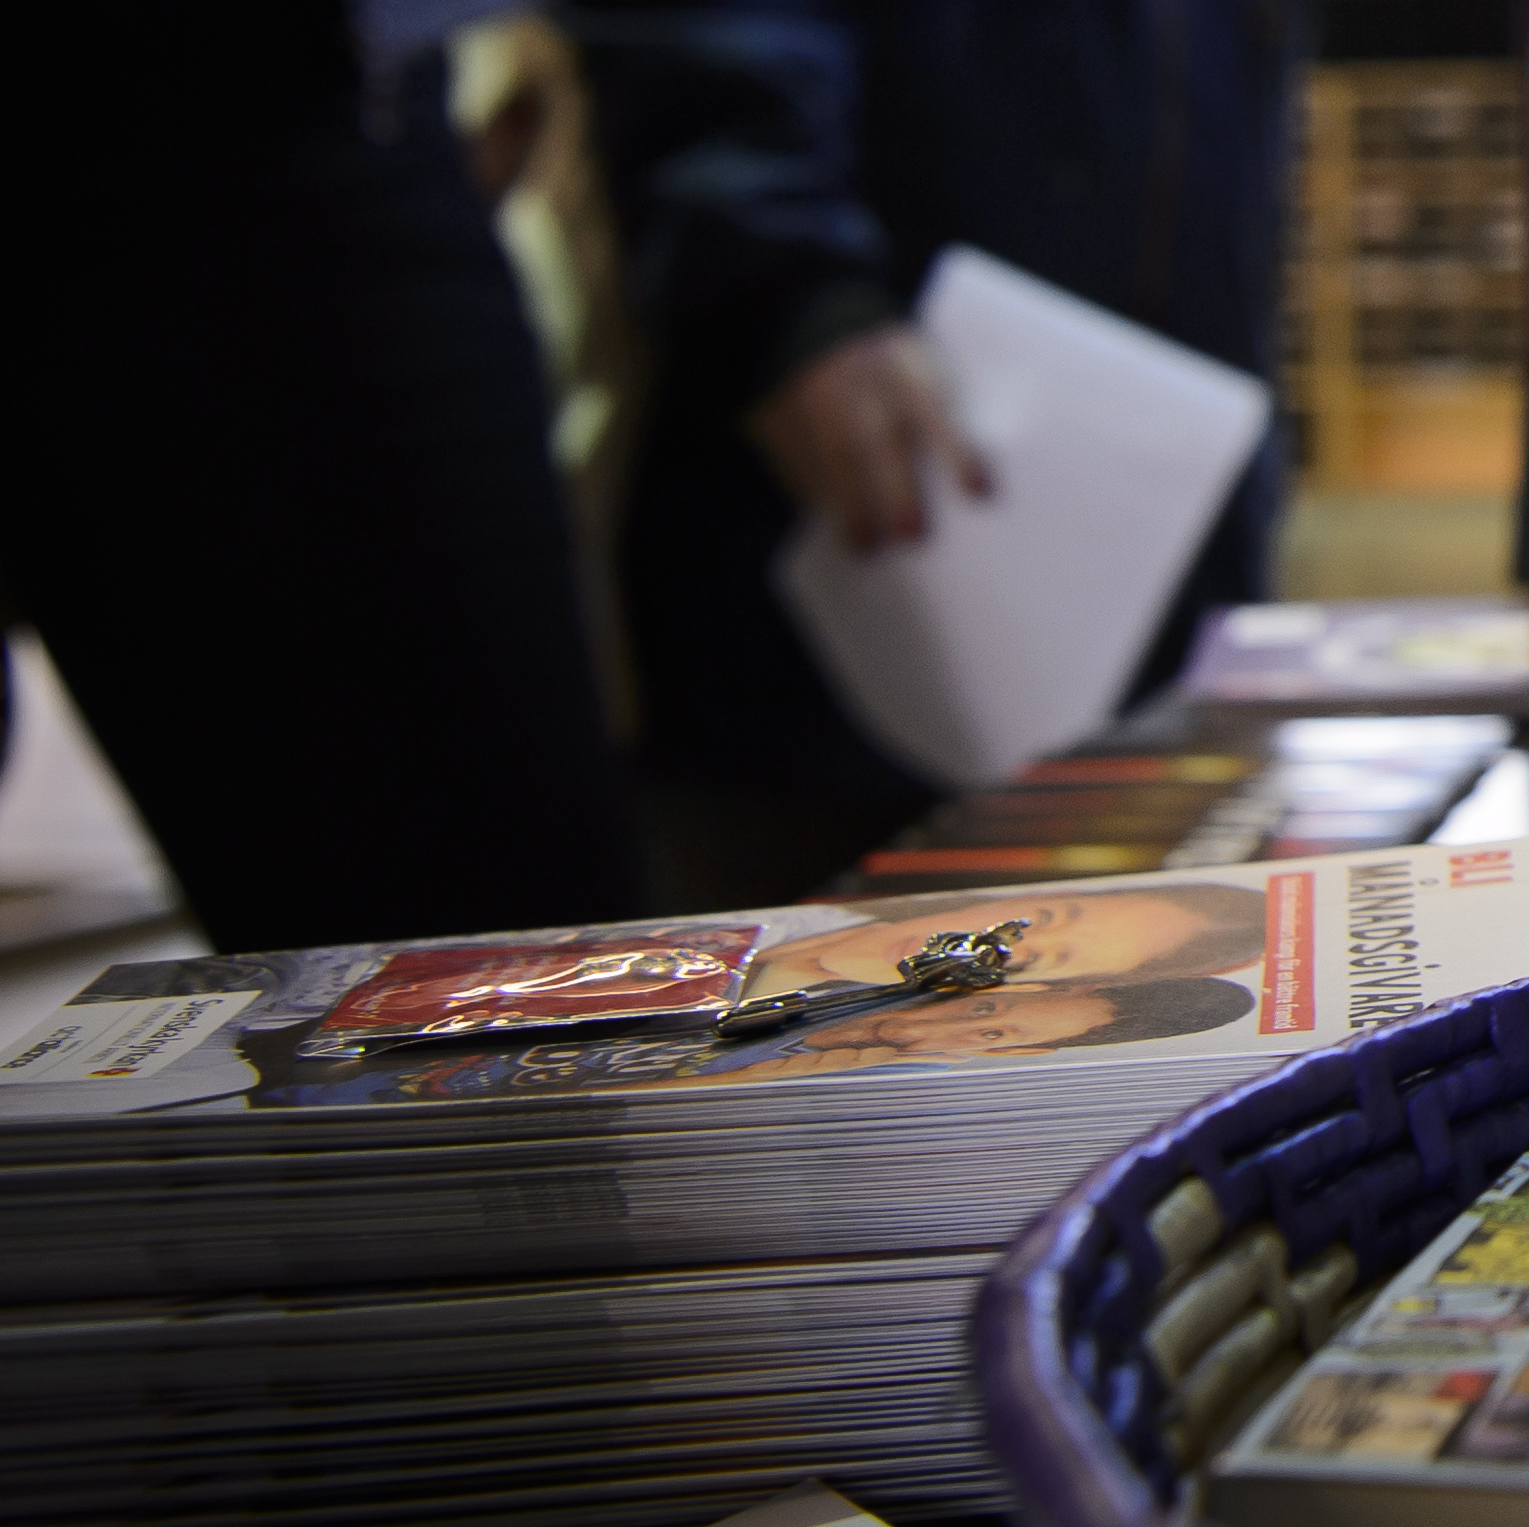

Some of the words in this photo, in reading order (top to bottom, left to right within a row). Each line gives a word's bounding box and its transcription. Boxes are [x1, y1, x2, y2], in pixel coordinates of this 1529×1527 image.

[1448, 849, 1514, 889] BLI
[148, 998, 225, 1038] Svenska
[1273, 1004, 1300, 1030] framtid
[107, 1037, 185, 1068] kyrkan
